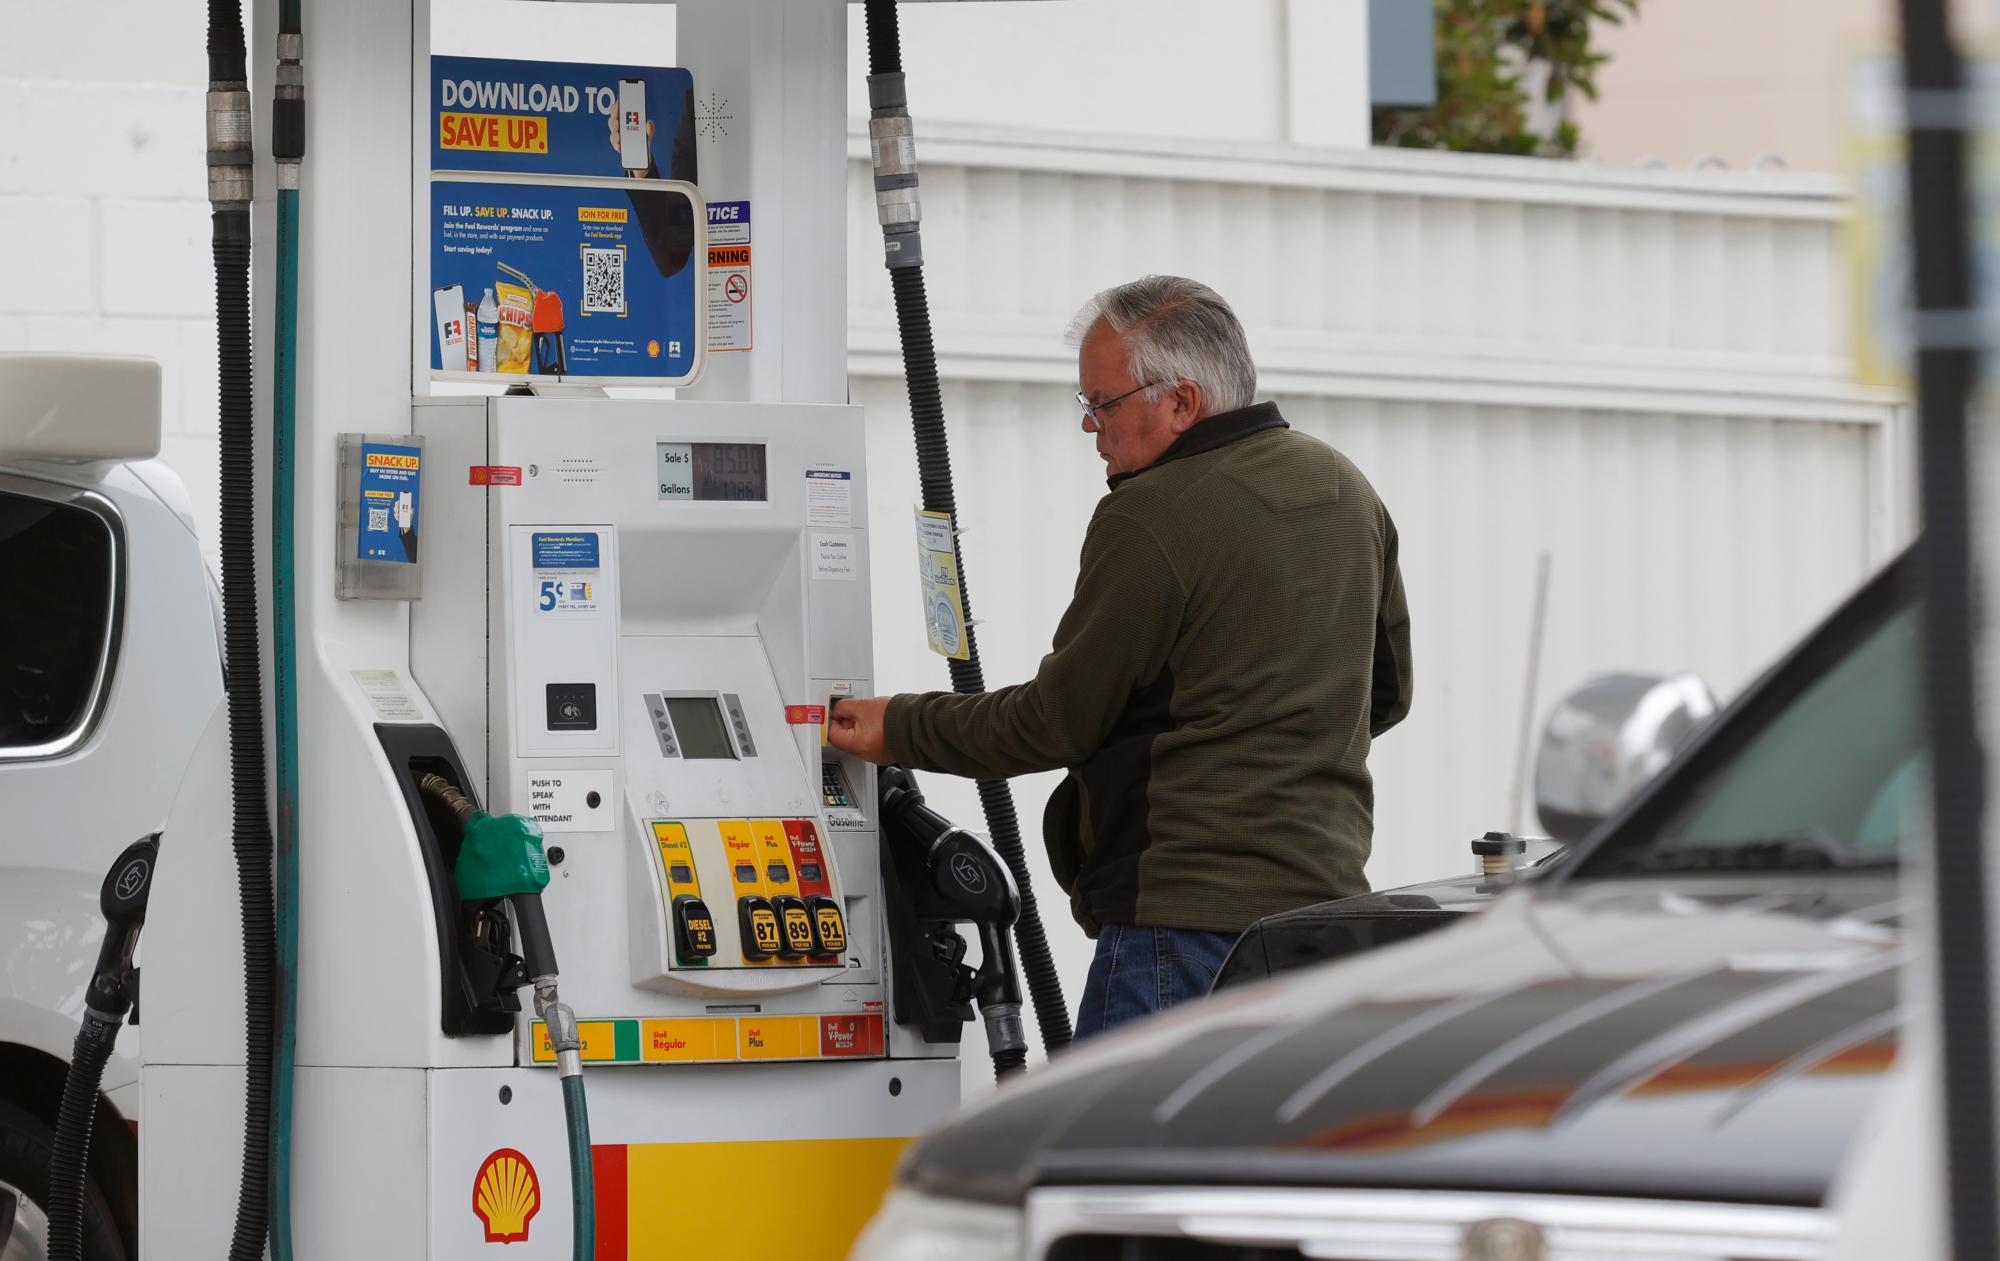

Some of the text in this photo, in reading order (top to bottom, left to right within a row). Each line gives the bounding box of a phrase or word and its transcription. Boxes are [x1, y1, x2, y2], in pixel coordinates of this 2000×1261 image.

[442, 79, 615, 116] DOWNLOAD TO
[442, 116, 545, 150] SAVE UP.
[444, 206, 554, 220] FILL UP. SAVE UP. SNACK UP.
[580, 210, 624, 220] JOIN FOR FREE
[708, 206, 739, 220] TICE
[464, 222, 476, 230] Fuel
[444, 244, 492, 255] Start saving today!
[708, 250, 749, 264] RNING
[500, 306, 532, 330] CHIPS
[368, 456, 418, 468] SNACK UP.
[664, 452, 689, 464] Sale $
[660, 483, 690, 494] Gallons
[728, 841, 750, 850] Regular
[688, 919, 712, 930] DIESEL
[789, 922, 809, 939] 89
[821, 921, 842, 939] 91
[698, 931, 707, 942] #2
[756, 922, 774, 940] 87
[748, 1029, 760, 1037] Shell
[828, 1023, 838, 1031] Shell
[748, 1037, 763, 1047] Plus
[828, 1032, 853, 1040] V-Power
[653, 1038, 686, 1051] Regular
